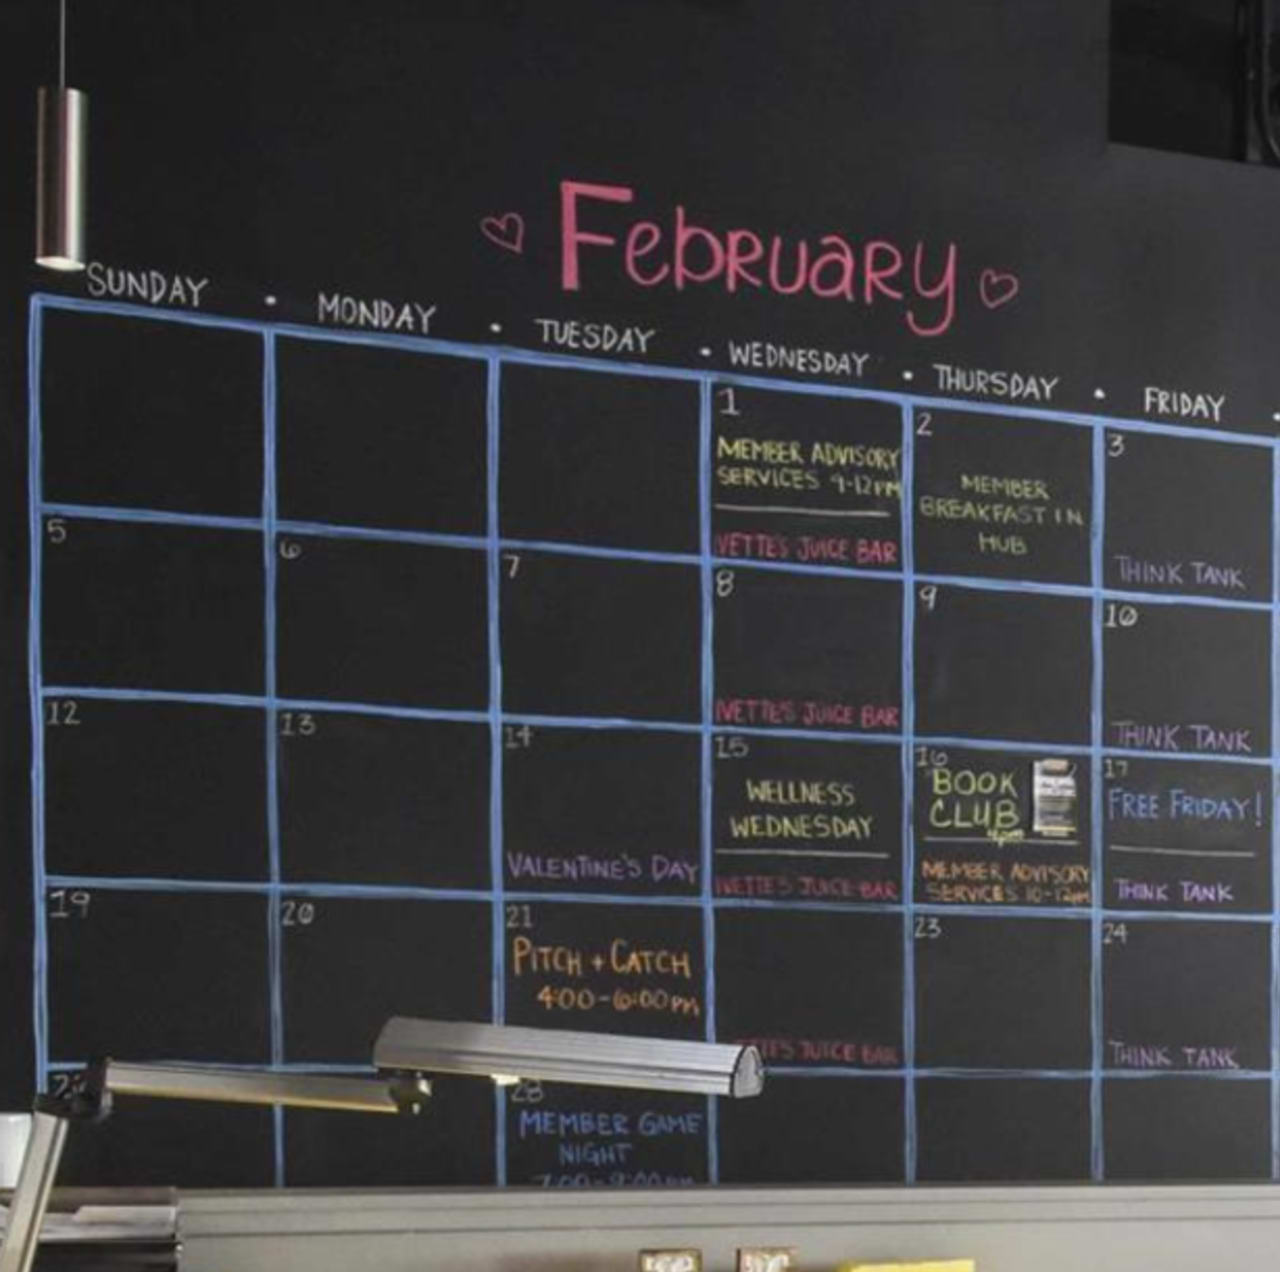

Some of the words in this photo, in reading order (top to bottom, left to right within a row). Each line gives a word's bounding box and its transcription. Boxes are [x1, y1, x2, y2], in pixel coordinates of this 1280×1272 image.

[560, 180, 956, 336] February
[87, 262, 208, 307] SUNDAY
[318, 292, 436, 335] MONDAY
[534, 318, 655, 352] TUESDAY
[729, 341, 869, 376] WEDNESDAY
[933, 364, 1059, 399] THURSDAY
[1144, 387, 1225, 421] FRIDAY
[718, 388, 740, 416] 1
[917, 412, 932, 436] 2
[717, 436, 804, 464] MEMBER
[811, 442, 900, 471] ADVISORY
[1108, 433, 1124, 457] 3
[717, 466, 820, 490] SERVICES
[961, 474, 1050, 500] MEMBER
[920, 496, 1046, 524] BREAKFAST
[1055, 508, 1083, 525] IN
[47, 519, 66, 543] 5
[280, 539, 301, 559] 6
[798, 537, 849, 560] JUICE
[857, 539, 897, 563] BAR
[979, 532, 1027, 556] HUB
[503, 554, 520, 578] 7
[1113, 556, 1183, 585] THINK
[1190, 562, 1245, 589] TANK
[716, 570, 734, 597] 8
[919, 585, 937, 611] 9
[1106, 604, 1138, 628] 10
[47, 700, 80, 725] 12
[280, 713, 316, 736] 13
[803, 702, 853, 726] JUICE
[861, 704, 899, 728] BAR
[505, 725, 534, 749] 14
[715, 736, 750, 759] 15
[1112, 720, 1180, 749] THINK
[1189, 724, 1251, 751] TANK
[916, 747, 948, 767] 16
[1104, 758, 1128, 779] 17
[746, 779, 855, 806] WELLNESS
[932, 768, 1018, 798] BOOK
[930, 798, 1019, 829] CLUB
[1108, 788, 1158, 820] FREE
[730, 814, 873, 839] WEDNESDAY
[508, 852, 642, 880] VALENTINE'S
[652, 854, 699, 885] DAY
[922, 859, 1003, 881] MEMBER
[1010, 862, 1089, 884] ADVISORY
[798, 876, 855, 897] JUICE
[859, 879, 898, 900] BAR
[926, 882, 1018, 903] SERVICES
[1115, 877, 1168, 901] THINK
[1180, 880, 1233, 902] TANK
[51, 890, 90, 918] 19
[282, 900, 315, 926] 20
[507, 904, 533, 929] 21
[915, 917, 942, 938] 23
[1104, 923, 1128, 944] 24
[512, 936, 582, 977] PITCH
[610, 938, 691, 979] CATCH
[1109, 1040, 1172, 1065] THINK
[1182, 1046, 1240, 1069] TANK
[520, 1110, 630, 1139] MEMBER
[638, 1112, 703, 1137] GAME
[559, 1142, 632, 1166] NIGHT
